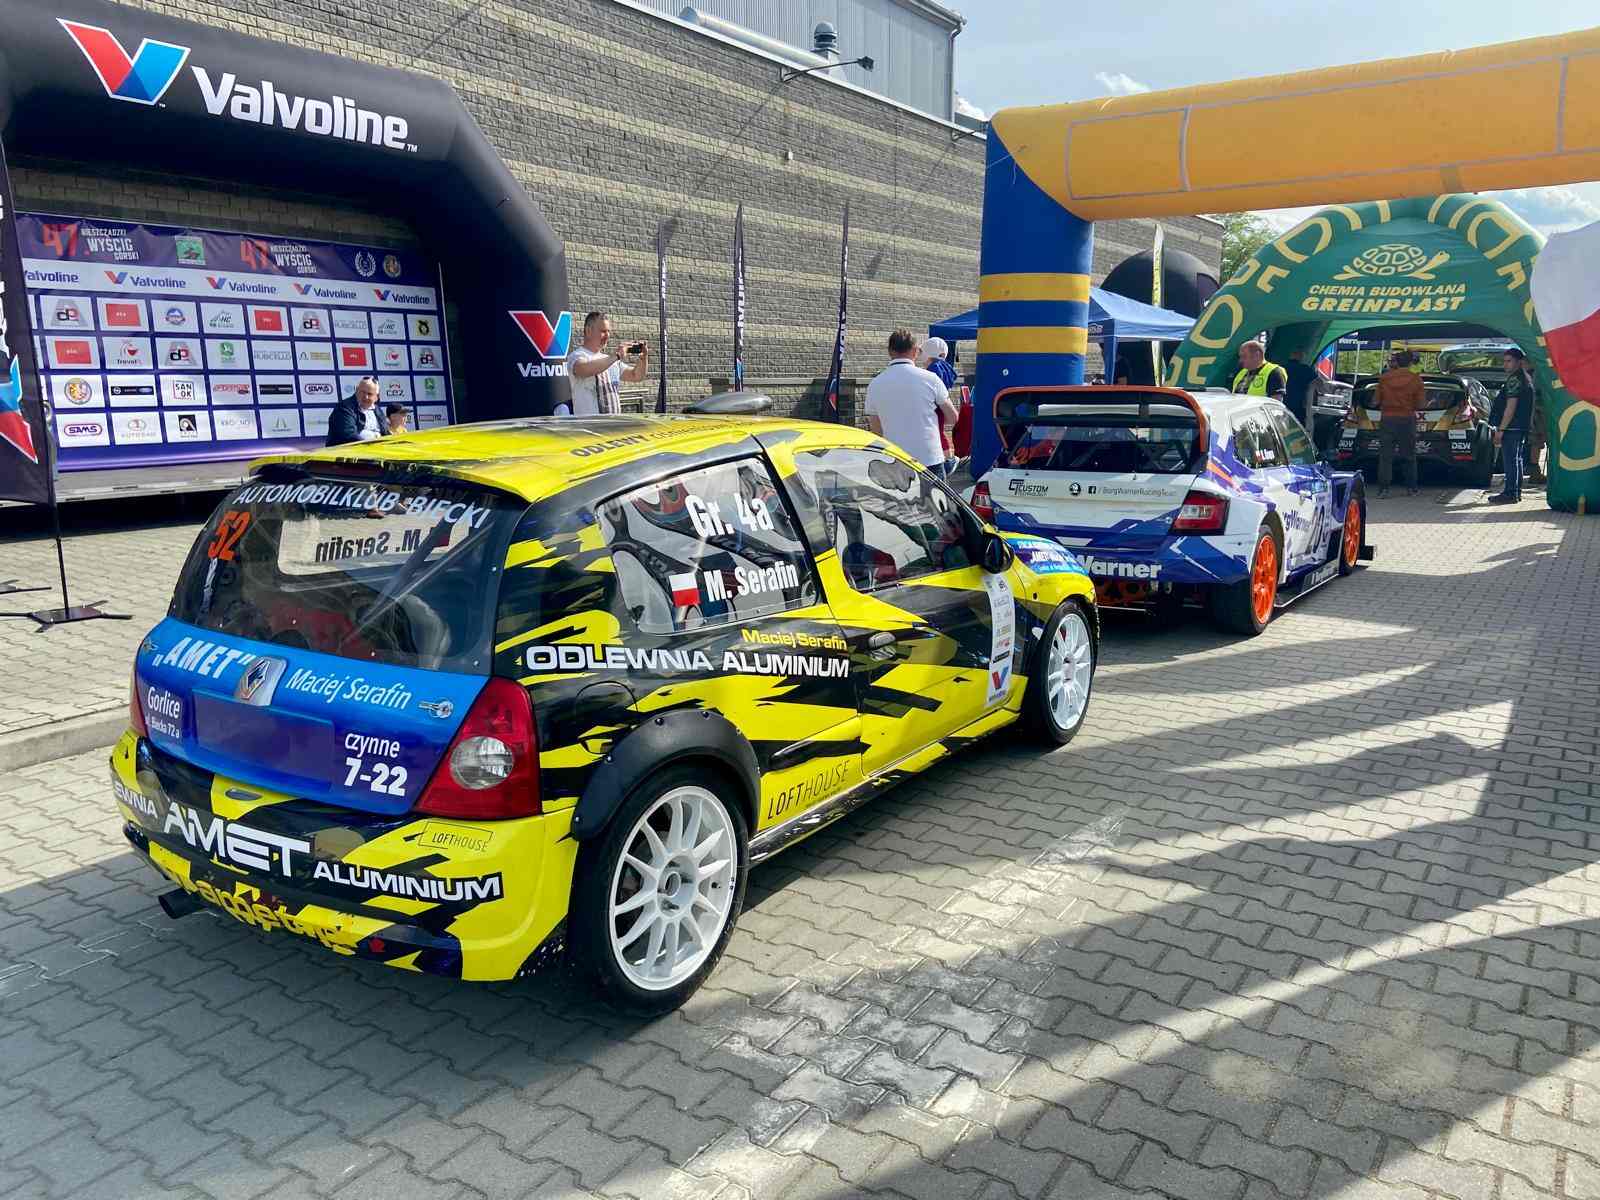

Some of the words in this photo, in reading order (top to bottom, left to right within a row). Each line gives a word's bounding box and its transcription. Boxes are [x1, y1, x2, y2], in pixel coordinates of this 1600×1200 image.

[191, 65, 409, 149] Valvoline
[42, 223, 78, 257] 47
[130, 276, 186, 289] Valvoline
[228, 282, 277, 295] Valvoline
[313, 287, 357, 300] Valvoline
[1308, 283, 1367, 296] CHEMIA
[1369, 283, 1466, 296] BUDOWLANA
[391, 293, 430, 305] Valvoline
[1302, 295, 1466, 313] GREINPLAST
[69, 425, 98, 434] SAMS
[232, 483, 401, 513] AUTOMOBILKLUB
[1018, 485, 1048, 493] CUSTOM
[685, 494, 735, 538] Gr.
[734, 492, 775, 532] 4a
[208, 510, 251, 560] 52
[703, 569, 733, 602] M.
[734, 560, 799, 596] Serafin
[742, 629, 796, 648] Maciej
[796, 633, 848, 650] Serafin
[525, 645, 715, 671] ODLEWNIA
[722, 651, 849, 678] ALUMINIUM
[147, 686, 180, 719] Gorlice
[286, 667, 345, 703] Maciej
[343, 677, 413, 711] Serafin
[344, 732, 401, 759] czynne
[343, 757, 409, 797] 7-22
[767, 759, 850, 820] LOFTHOUSE
[164, 802, 311, 878] AMET
[431, 831, 490, 853] LOFTHOUSE
[313, 861, 503, 902] ALUMINIUM
